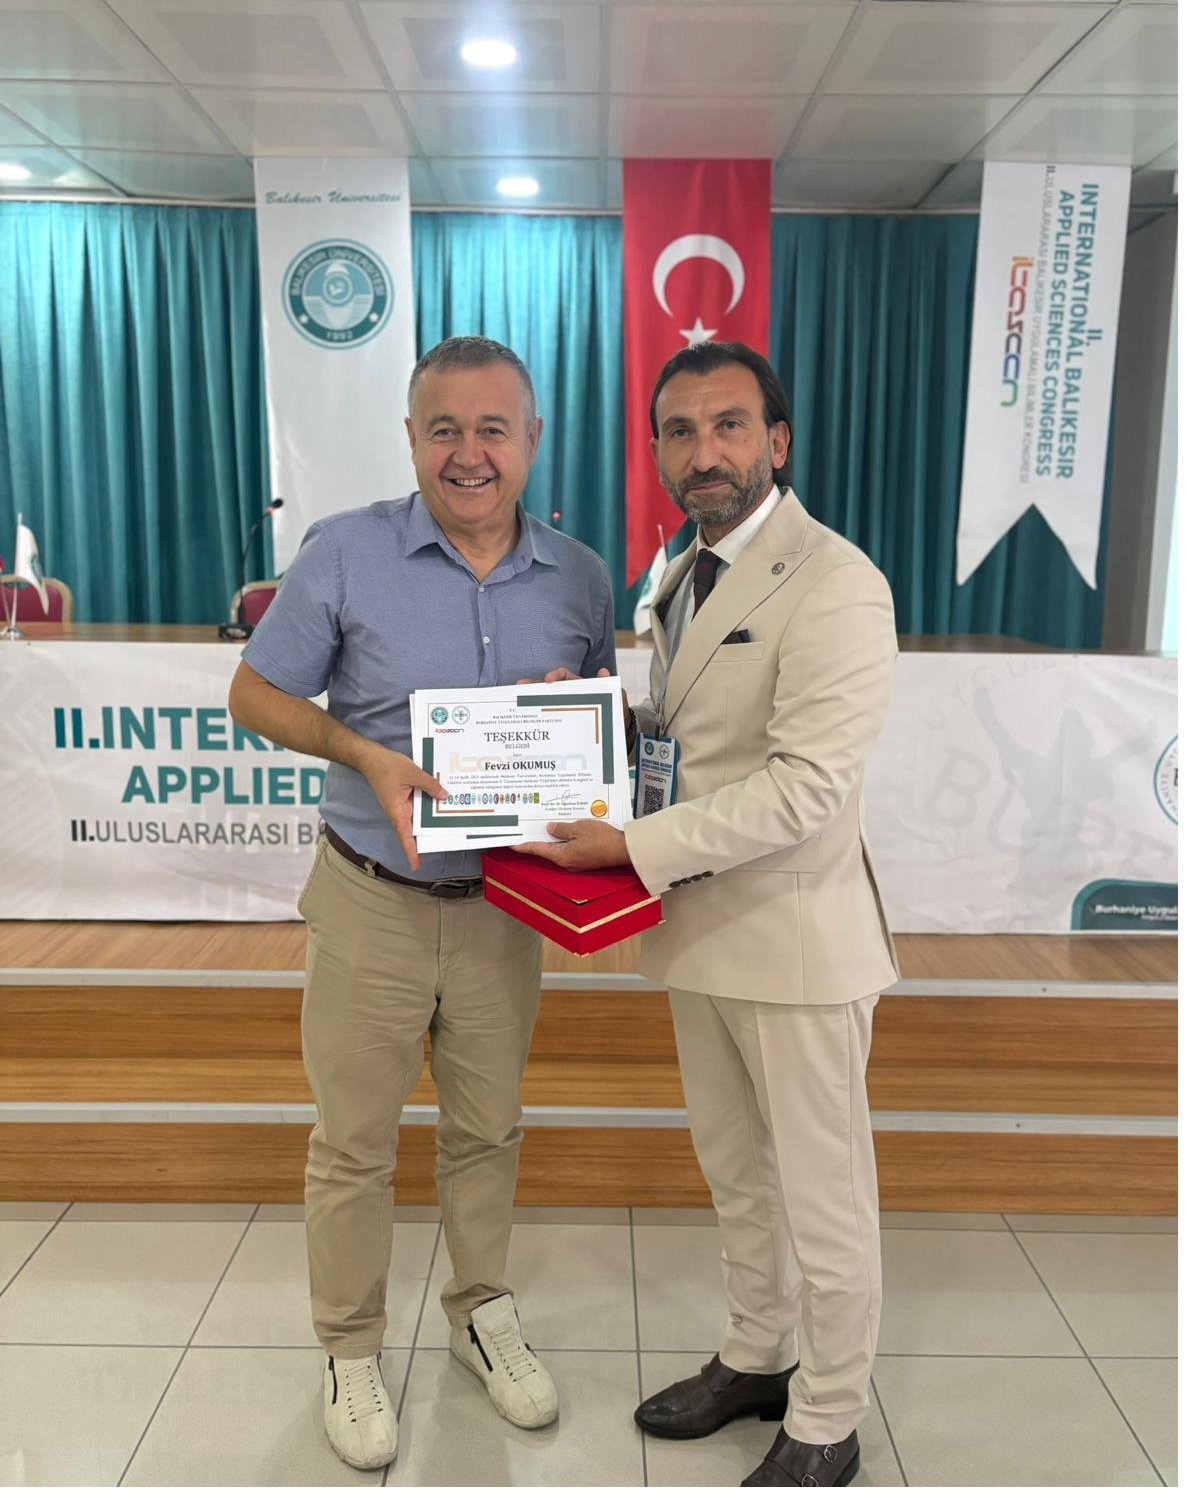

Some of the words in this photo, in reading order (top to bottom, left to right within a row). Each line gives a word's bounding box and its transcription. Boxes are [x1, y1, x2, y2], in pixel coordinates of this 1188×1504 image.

[1053, 190, 1075, 275] APPLIED
[1065, 183, 1099, 363] INTERNATIONAL
[1044, 279, 1067, 372] SCIENCES
[1035, 376, 1058, 476] CONGRESS
[1056, 368, 1082, 479] BALIKESIR
[54, 706, 284, 751] II.INTER
[483, 729, 551, 743] TEŞEKKÜR
[121, 765, 326, 805] APPLIED
[484, 761, 511, 771] Fevzi
[512, 760, 556, 772] OKUMUŞ
[71, 819, 288, 845] II.ULUSLARARASI
[298, 823, 320, 845] B
